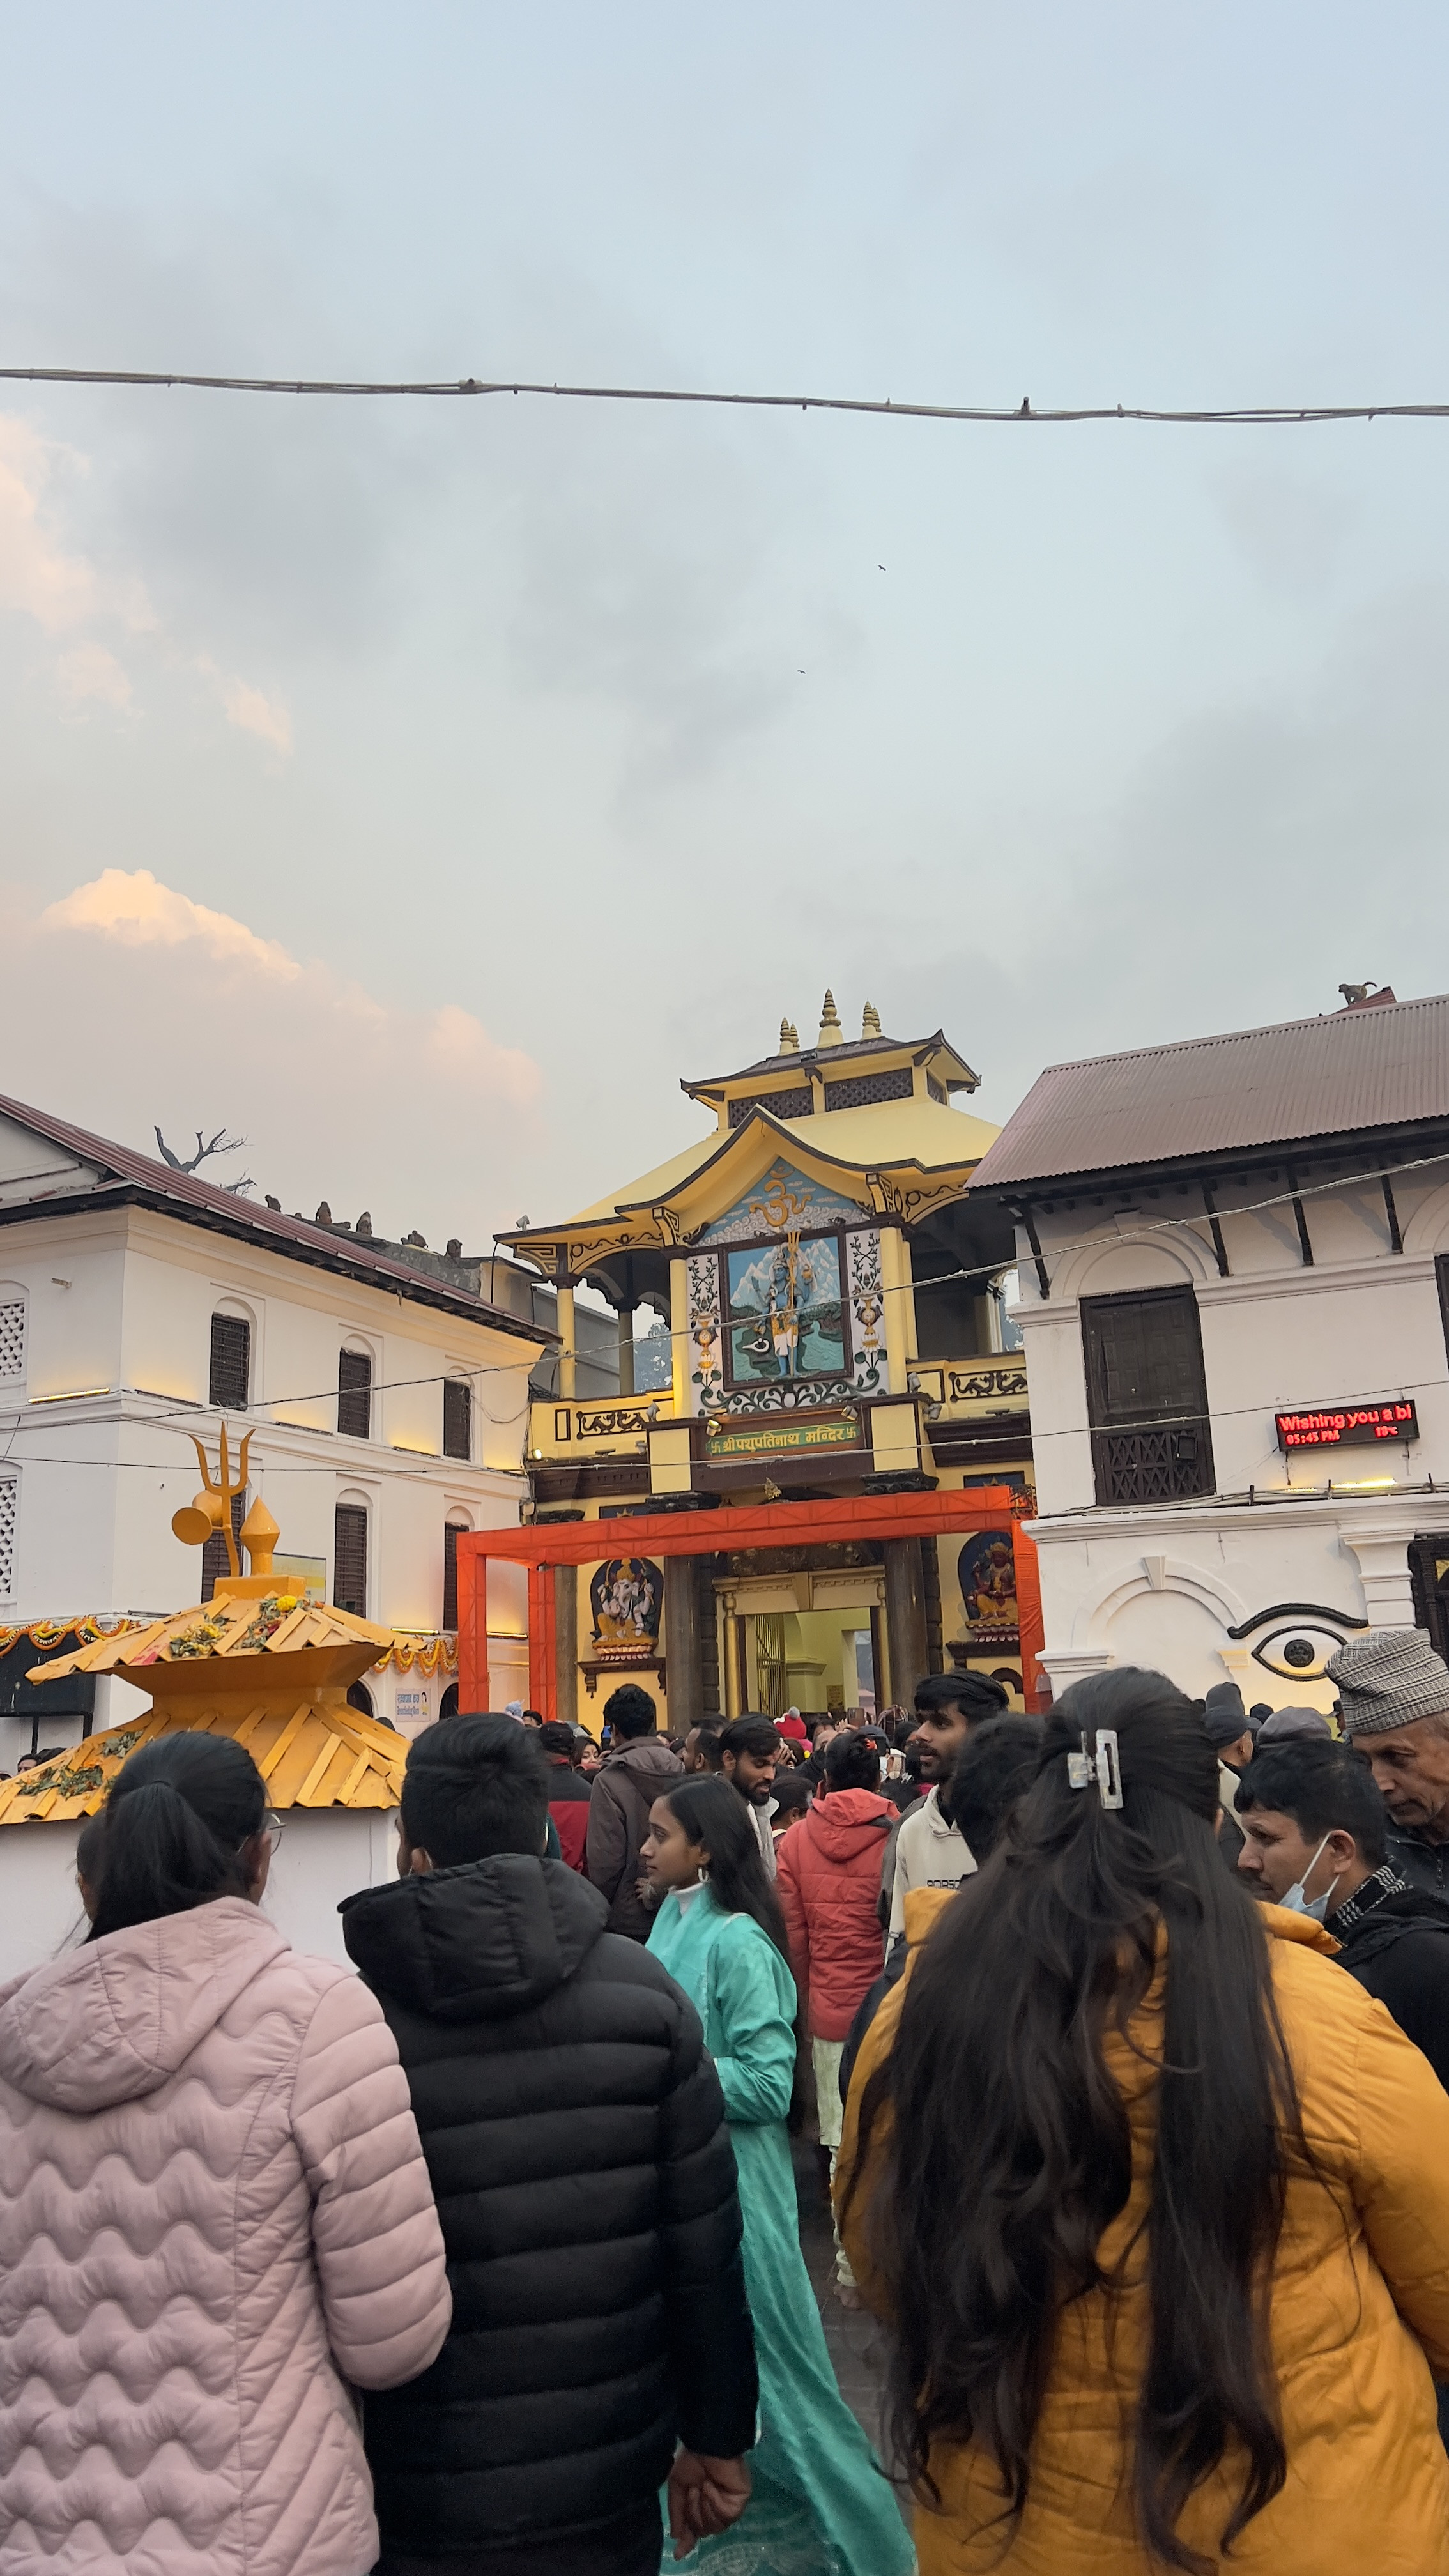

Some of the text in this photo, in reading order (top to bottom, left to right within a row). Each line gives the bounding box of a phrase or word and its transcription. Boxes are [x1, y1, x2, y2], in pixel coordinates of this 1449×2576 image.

[1279, 1414, 1345, 1432] Wishing
[1347, 1410, 1379, 1429] you
[1381, 1409, 1393, 1422] a
[806, 1425, 845, 1443] मन्दिर
[1286, 1432, 1319, 1445] 05:45
[1321, 1429, 1340, 1441] PM
